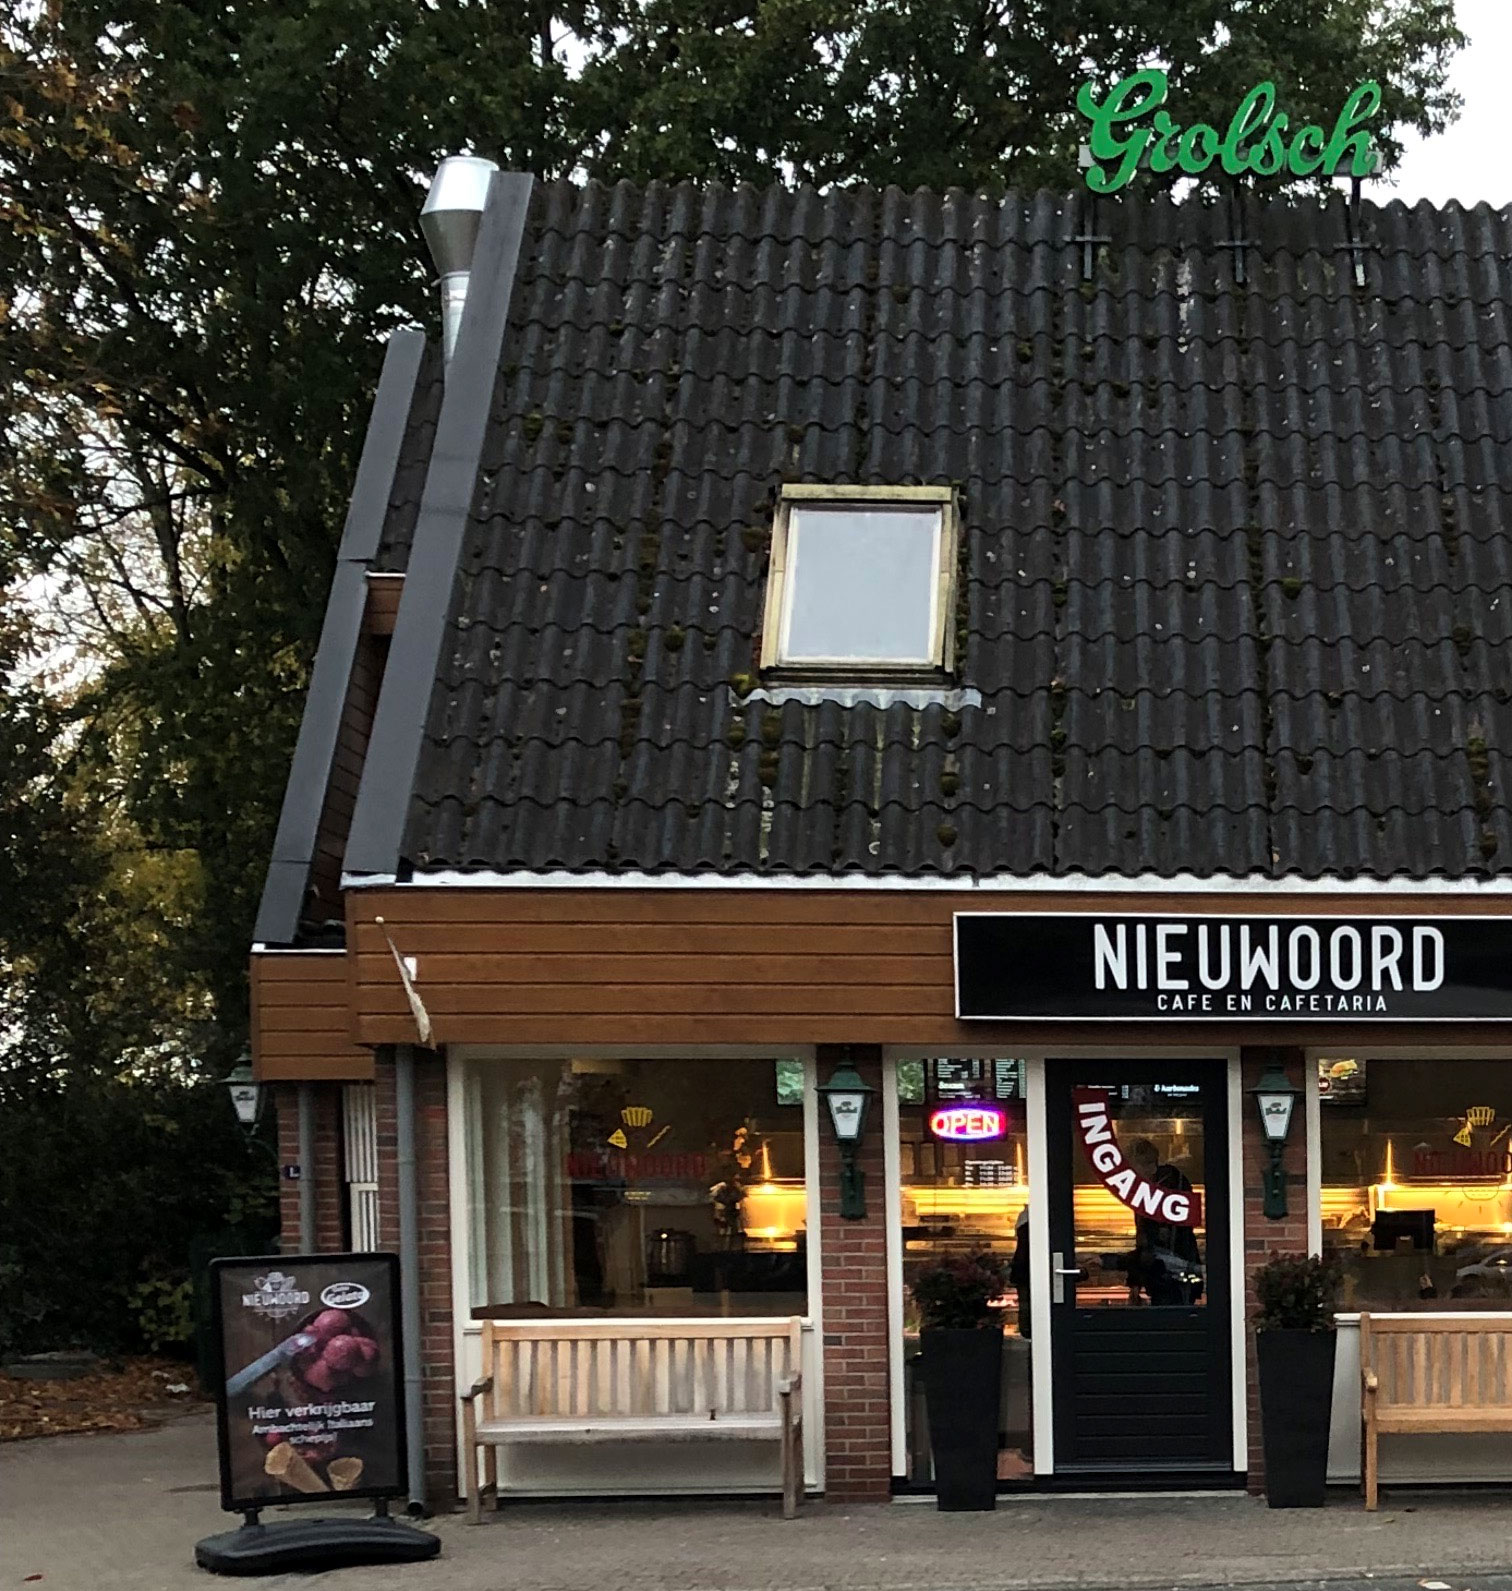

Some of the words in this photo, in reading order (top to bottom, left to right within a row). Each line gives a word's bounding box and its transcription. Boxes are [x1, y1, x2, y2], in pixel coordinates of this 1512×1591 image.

[1077, 69, 1381, 193] Grolsch
[1093, 923, 1446, 991] NIEUWOORD
[1157, 994, 1212, 1011] CAFE
[1226, 995, 1254, 1011] EN
[1265, 995, 1388, 1012] CAFETARIA
[932, 1113, 999, 1134] OPEN
[1078, 1101, 1190, 1222] INGANG
[242, 1291, 310, 1306] NIEUWOORD
[248, 1406, 281, 1419] Hier
[285, 1401, 376, 1417] verkrijgbaar
